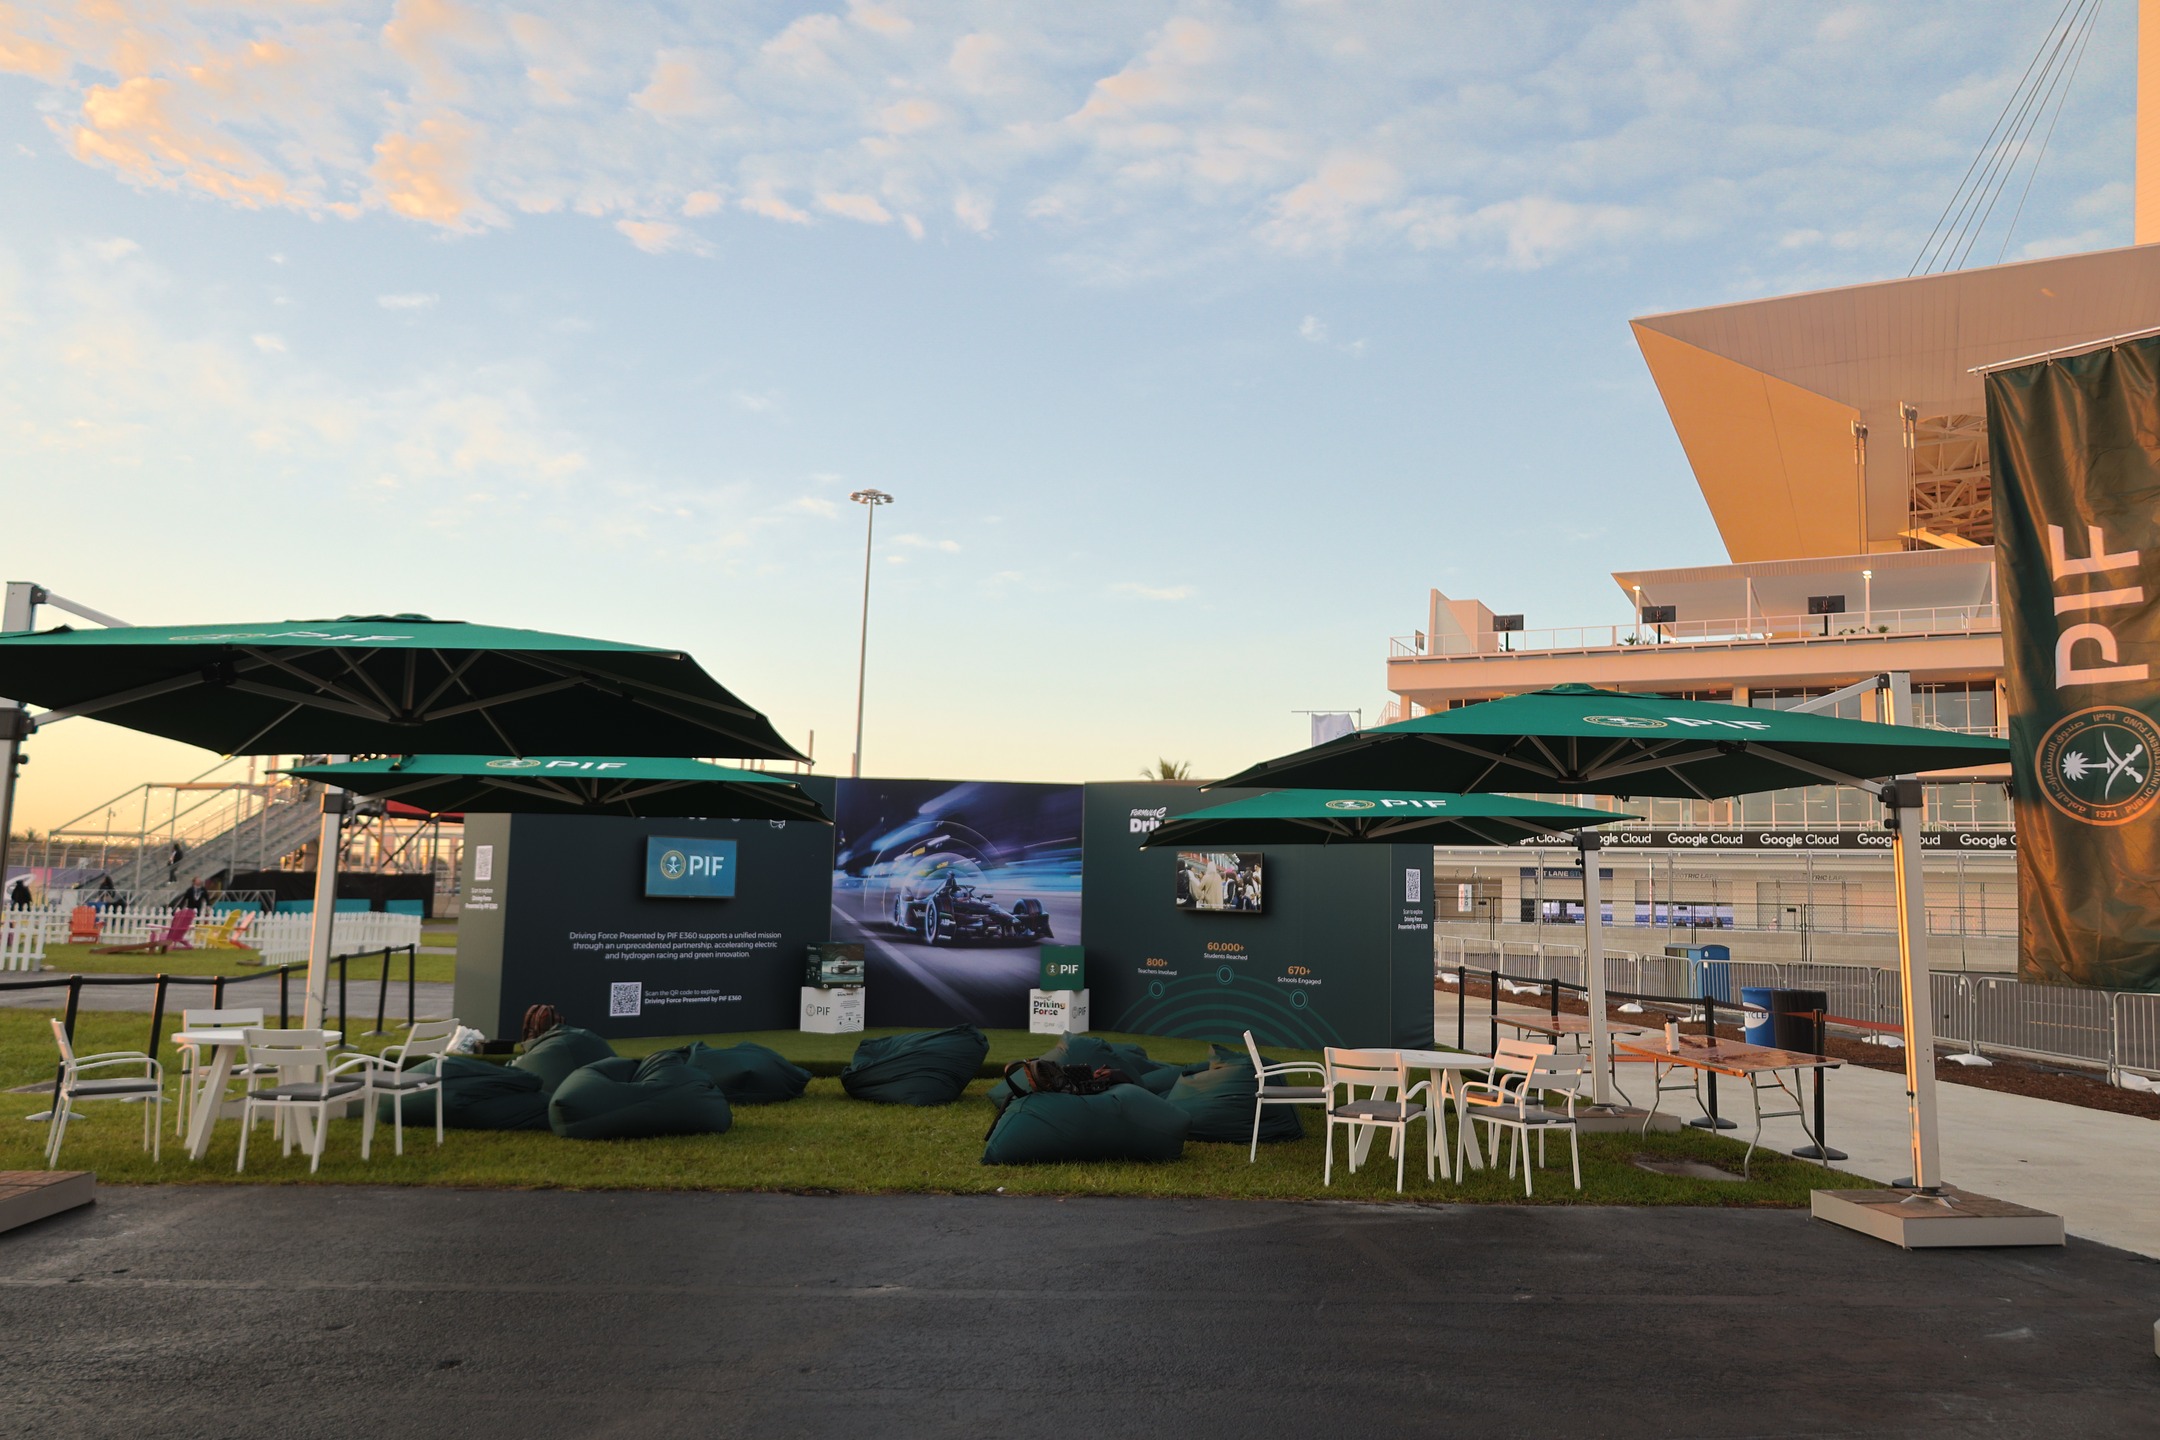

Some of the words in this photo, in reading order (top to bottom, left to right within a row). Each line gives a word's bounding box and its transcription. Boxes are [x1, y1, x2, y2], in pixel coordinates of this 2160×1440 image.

[2048, 524, 2149, 690] PIF
[266, 631, 415, 642] PIF
[1662, 717, 1772, 731] PIF
[2122, 716, 2149, 734] FUND
[545, 760, 628, 770] PIF
[1379, 799, 1447, 808] PIF
[2124, 787, 2154, 814] PUBLIC
[2095, 810, 2117, 819] 1971
[1621, 833, 1652, 844] Cloud
[1667, 832, 1708, 846] Google
[1710, 833, 1743, 844] Cloud
[1760, 833, 1803, 847] Google
[1805, 834, 1840, 845] Cloud
[1857, 833, 1893, 847] Goog
[1920, 834, 1941, 845] oud
[1960, 833, 2008, 848] Google
[689, 855, 725, 876] PIF
[569, 931, 597, 941] Driving
[597, 931, 618, 939] Force
[619, 931, 656, 939] Presented
[657, 931, 666, 941] by
[667, 931, 679, 939] PIF
[679, 931, 698, 939] E360
[698, 932, 728, 940] supports
[734, 931, 757, 939] unified
[573, 942, 604, 951] through
[616, 941, 671, 951] unprecedented
[714, 941, 754, 949] accelerating
[1207, 942, 1245, 952] 60,000+
[621, 952, 655, 960] hydrogen
[656, 951, 678, 960] racing
[694, 952, 714, 960] green
[1146, 958, 1168, 967] 800+
[1060, 964, 1079, 974] PIF
[1287, 966, 1312, 975] 670+
[1298, 977, 1322, 985] Engaged
[700, 988, 720, 996] explore
[1033, 1001, 1066, 1010] Driving
[816, 1006, 831, 1016] PIF
[1033, 1008, 1058, 1016] Force
